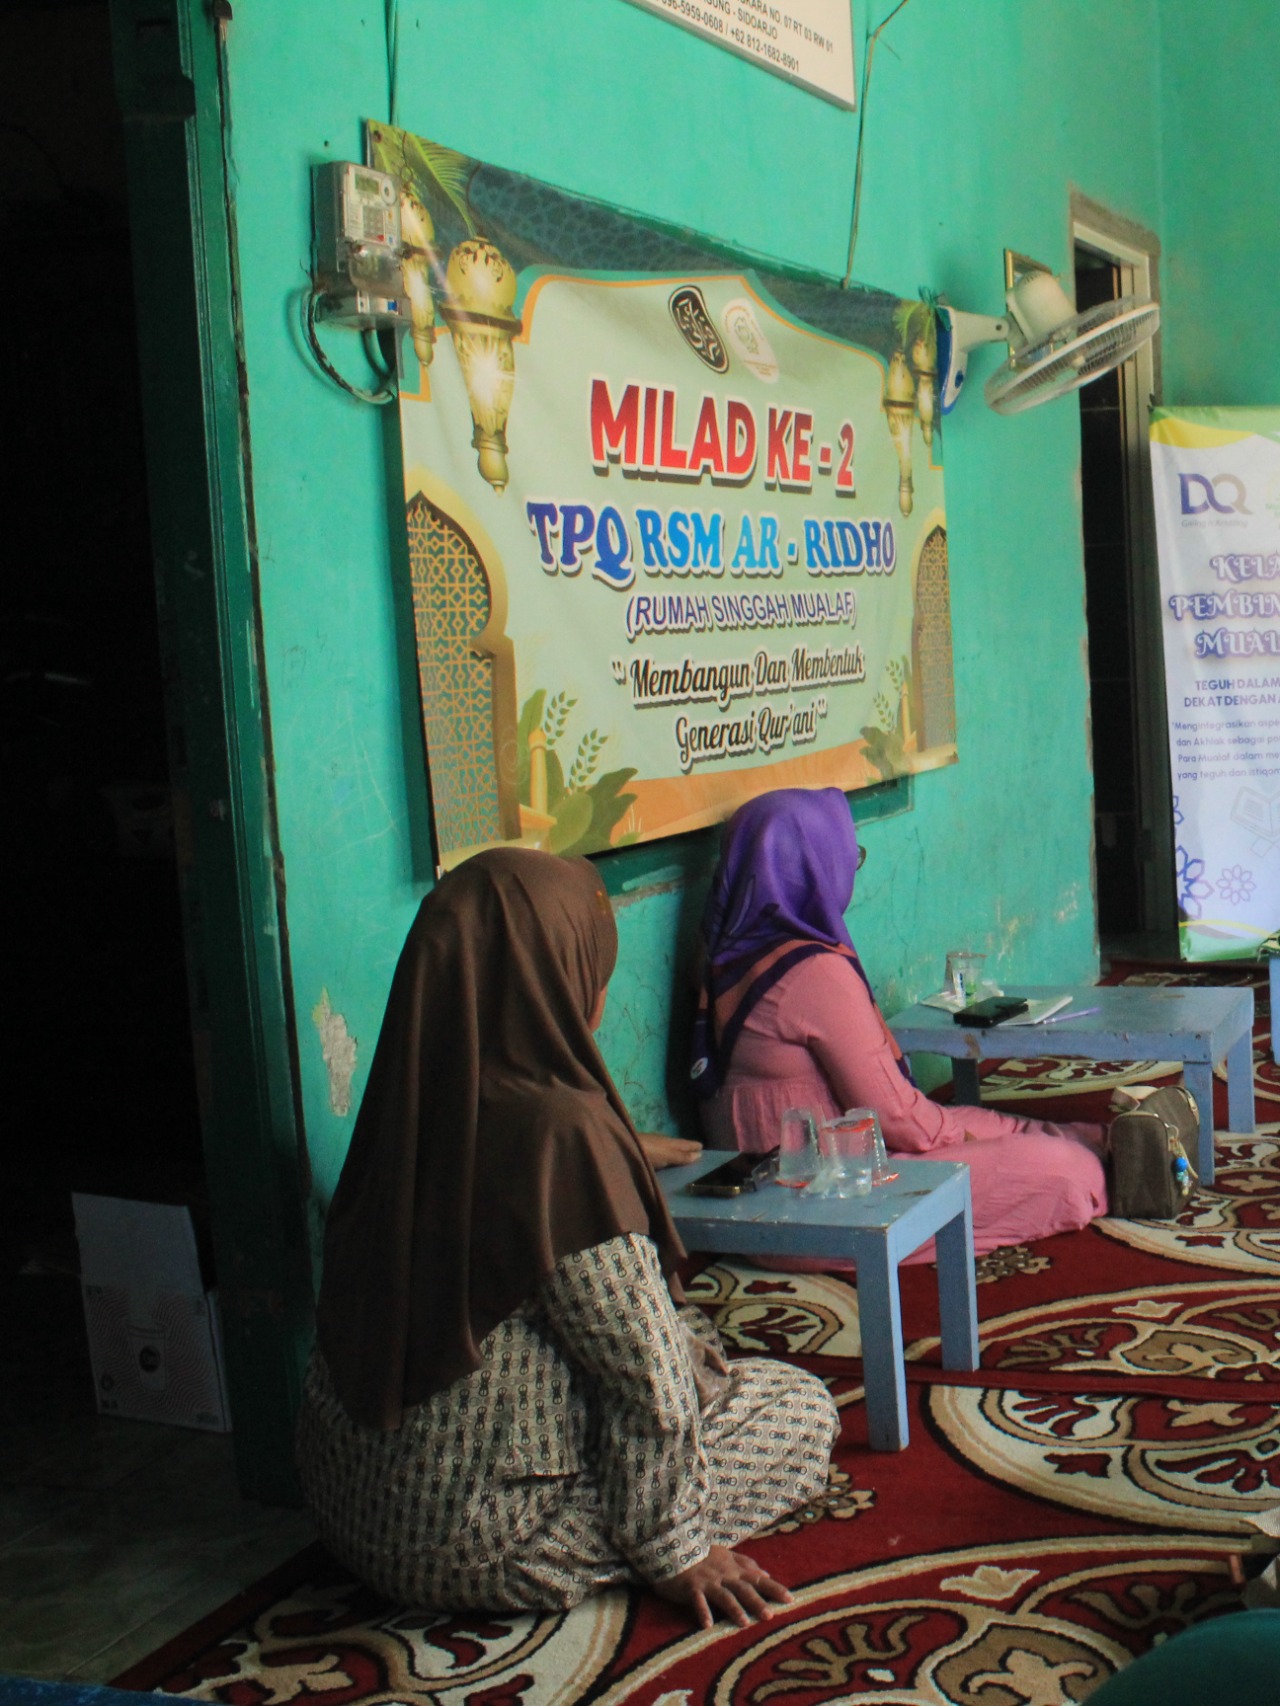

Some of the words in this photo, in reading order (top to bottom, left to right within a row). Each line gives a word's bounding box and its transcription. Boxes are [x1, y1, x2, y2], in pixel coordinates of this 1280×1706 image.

[731, 28, 745, 45] +62
[737, 7, 778, 40] SIDOARJO
[793, 20, 803, 37] RT
[813, 32, 825, 48] RW
[589, 377, 759, 479] MILAD
[766, 406, 814, 484] KE
[835, 421, 857, 489] 2
[1178, 473, 1254, 515] DQ
[526, 500, 633, 582] TPQ
[634, 508, 722, 569] RSM
[731, 514, 781, 570] AR
[803, 519, 896, 569] RIDHO
[626, 595, 711, 634] (RUMAH
[711, 594, 789, 624] SINGGAH
[790, 591, 857, 623] MUALAF)
[630, 658, 751, 701] Membangun
[753, 650, 787, 685] Dan
[791, 645, 865, 682] Membentuk
[1195, 679, 1235, 691] TEGUH
[1236, 677, 1280, 689] DALAM
[1184, 695, 1222, 707] DEKAT
[1224, 693, 1276, 706] DENGAN
[675, 710, 755, 764] Generasi
[1176, 737, 1192, 746] dan
[1193, 736, 1225, 746] Akhlak
[1227, 735, 1265, 746] sebagai
[1178, 754, 1197, 763] Para
[1198, 752, 1230, 762] Mualaf
[1233, 751, 1263, 760] dalam
[1177, 771, 1198, 781] yang
[1200, 769, 1226, 781] teguh
[1228, 768, 1247, 777] dan
